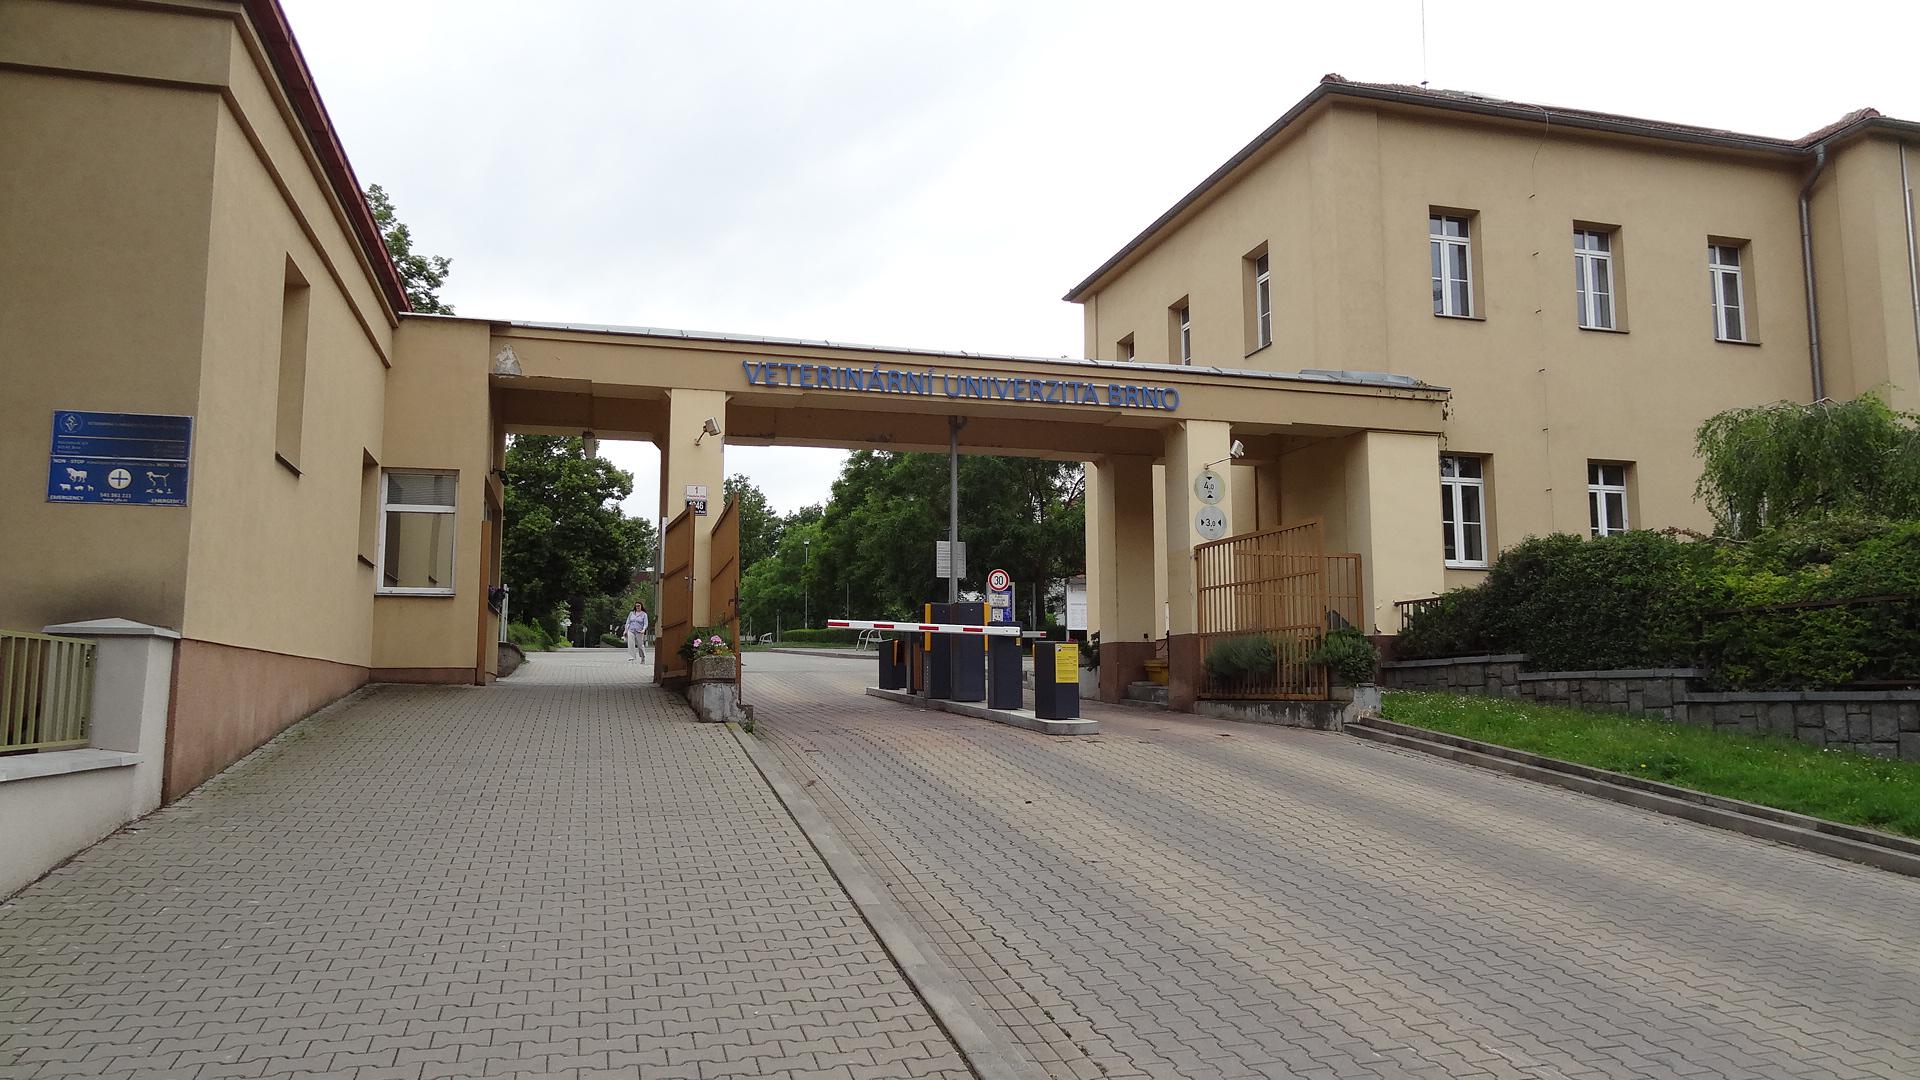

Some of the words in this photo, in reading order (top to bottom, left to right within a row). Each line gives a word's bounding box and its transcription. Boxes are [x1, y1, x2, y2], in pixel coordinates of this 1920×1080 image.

[742, 360, 935, 397] VETERINÁRNÍ
[943, 374, 1100, 405] UNIVERZITA
[1107, 383, 1181, 412] BRNO
[994, 575, 1004, 586] 30
